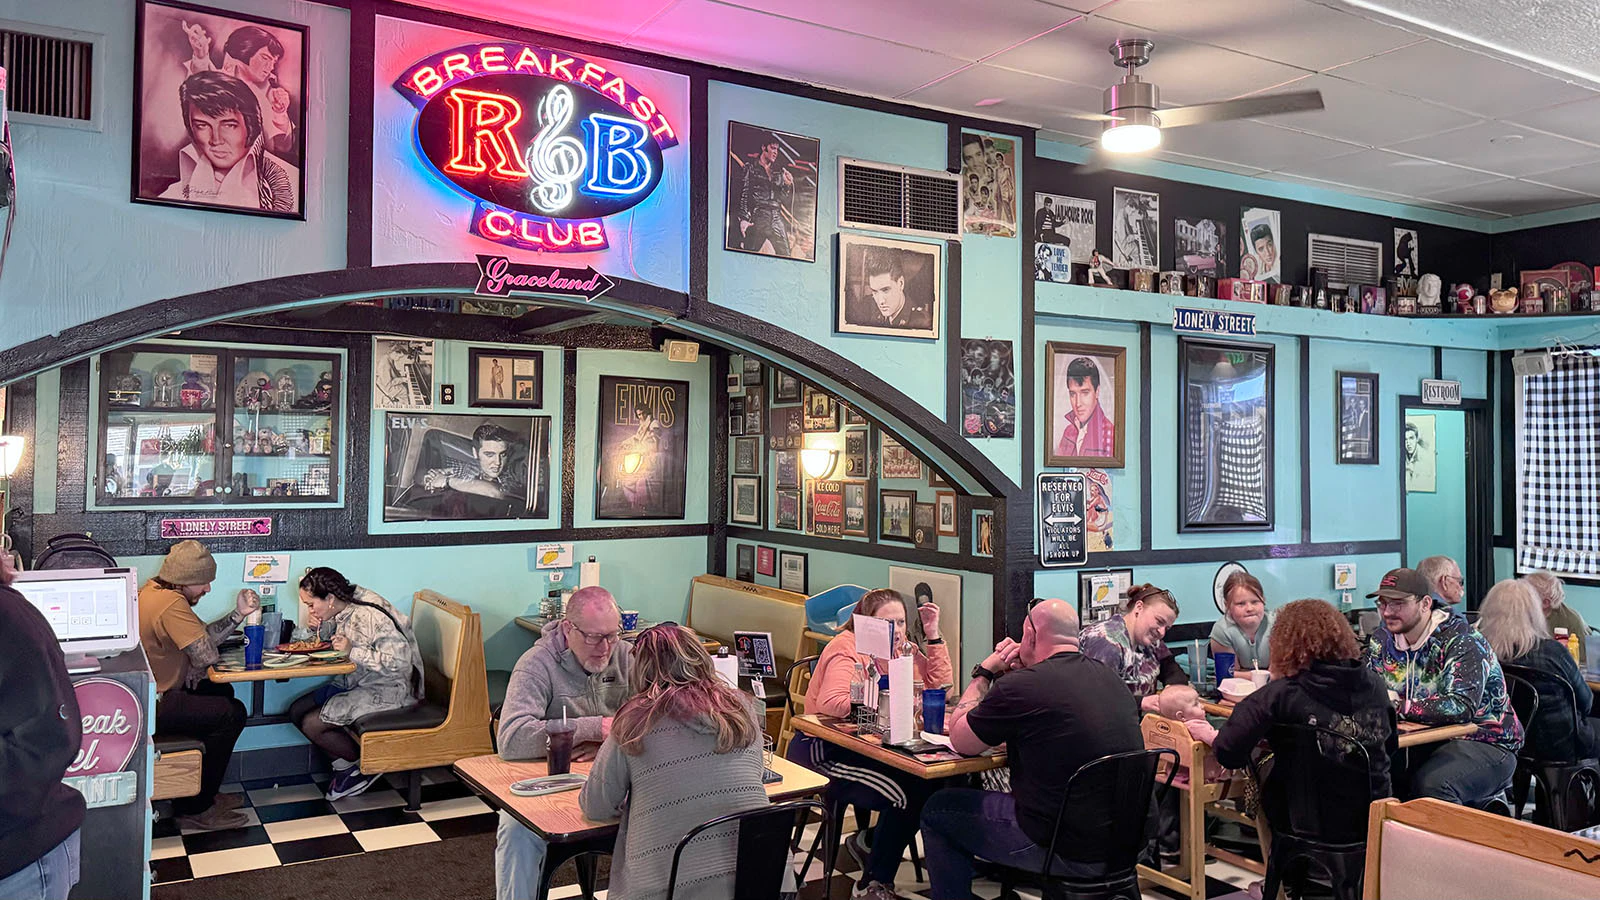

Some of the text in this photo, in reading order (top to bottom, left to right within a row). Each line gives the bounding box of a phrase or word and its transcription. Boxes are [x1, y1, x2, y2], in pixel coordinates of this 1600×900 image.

[413, 46, 674, 141] BREAKFAST
[1081, 207, 1094, 225] ROCK
[486, 211, 603, 246] CLUB
[1053, 248, 1065, 257] LOVE
[1051, 263, 1068, 272] TENDER
[486, 258, 601, 293] Graceland
[1179, 311, 1252, 333] LONELY STREET
[1423, 382, 1460, 401] RESTROOM
[615, 383, 676, 428] ELVIS
[816, 482, 840, 492] ICE COLD
[1042, 482, 1083, 492] RESERVED
[1055, 493, 1071, 502] FOR
[1052, 503, 1074, 513] ELVIS
[180, 520, 252, 532] LONELY STREET
[815, 523, 841, 535] SOLD HERE
[1046, 526, 1081, 534] VIOLATORS
